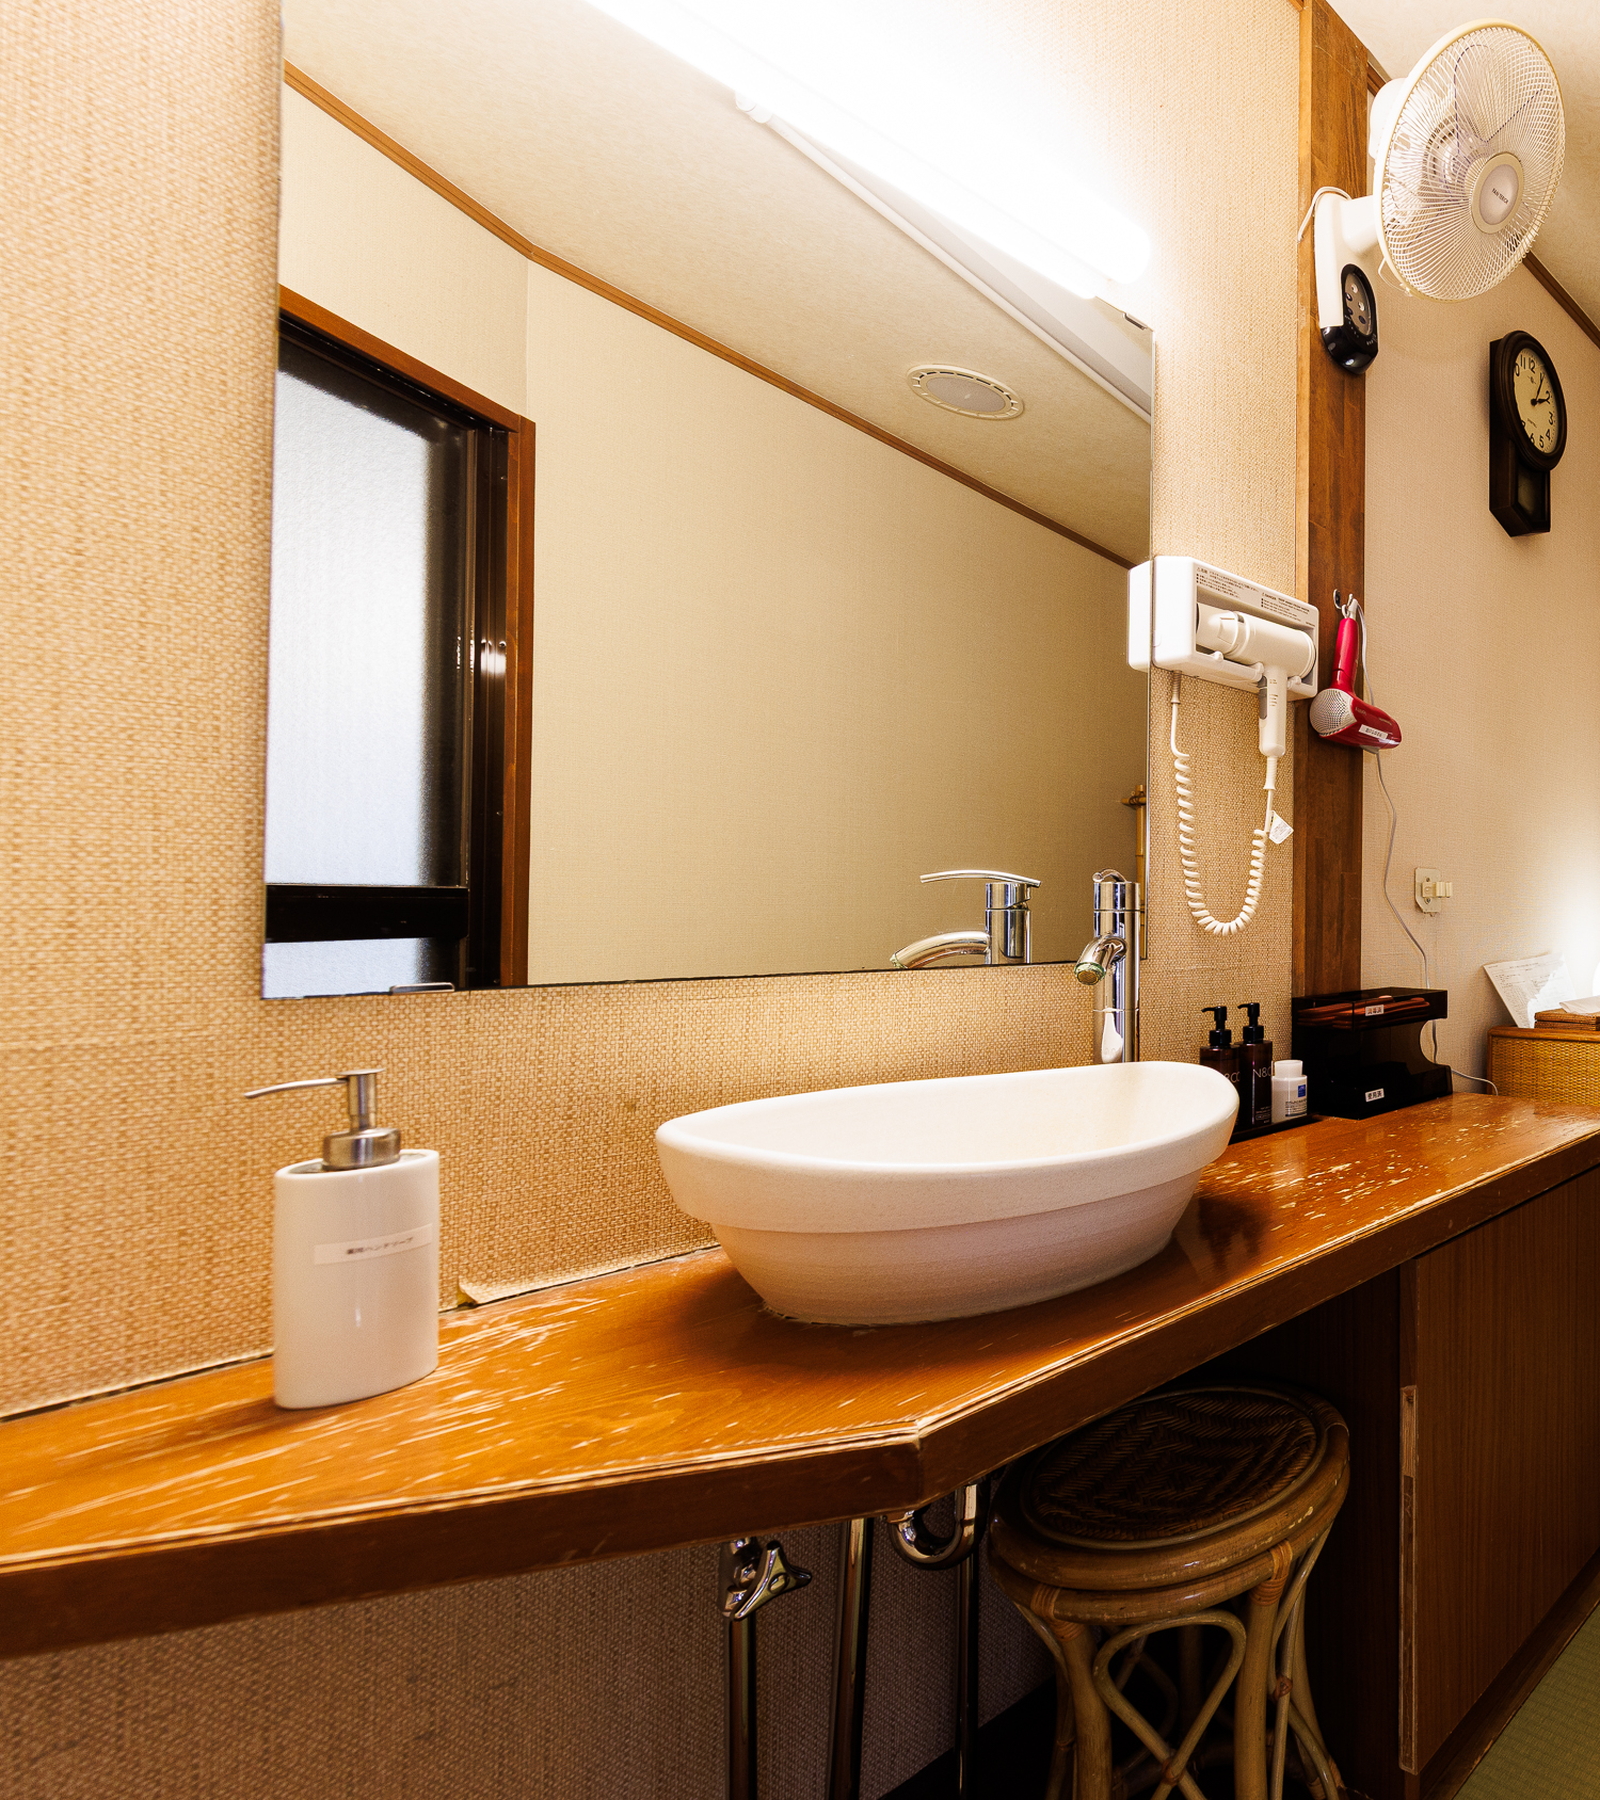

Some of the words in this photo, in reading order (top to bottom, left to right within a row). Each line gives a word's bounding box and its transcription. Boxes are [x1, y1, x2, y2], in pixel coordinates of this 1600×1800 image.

[1520, 354, 1526, 370] 11
[1528, 357, 1536, 374] 12
[1548, 411, 1554, 426] 3
[1539, 434, 1544, 449] 5
[1545, 428, 1551, 441] 4
